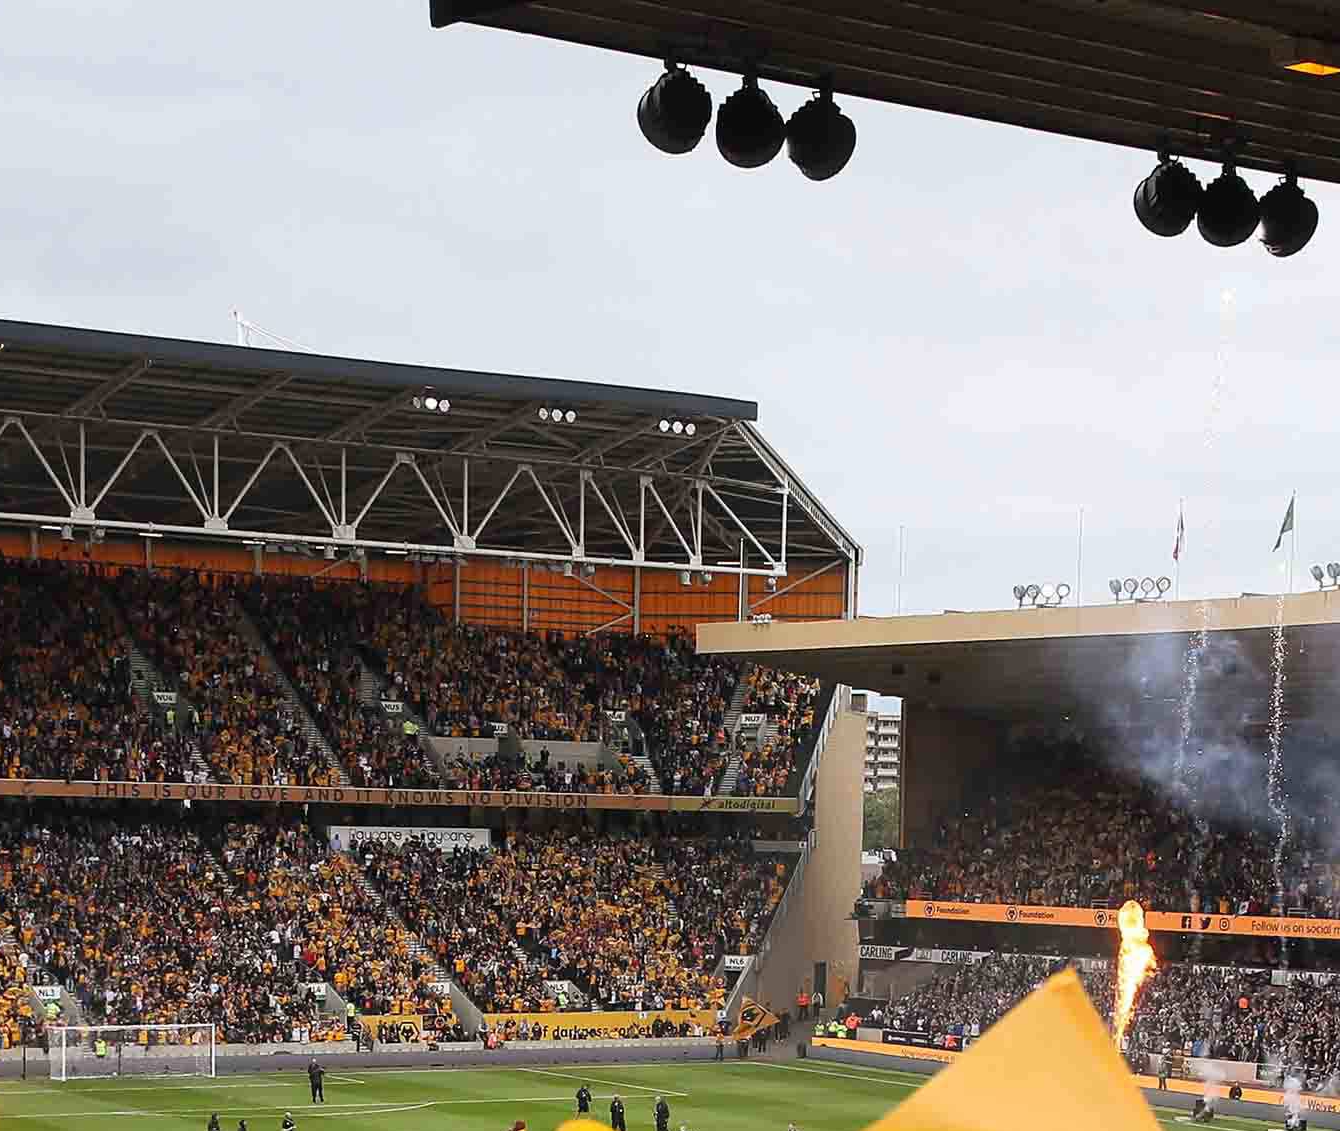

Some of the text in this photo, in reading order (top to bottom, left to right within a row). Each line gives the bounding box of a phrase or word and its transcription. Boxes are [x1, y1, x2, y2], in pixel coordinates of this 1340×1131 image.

[91, 782, 588, 807] THIS IS OUR LOVE AND IT KNOWS NO DIVISION
[1018, 911, 1054, 920] Foundation
[1251, 920, 1279, 932] Follow
[1281, 924, 1289, 932] us
[1292, 925, 1304, 933] on
[1306, 924, 1332, 935] social
[860, 946, 893, 959] CARLING
[941, 950, 973, 963] CARLING
